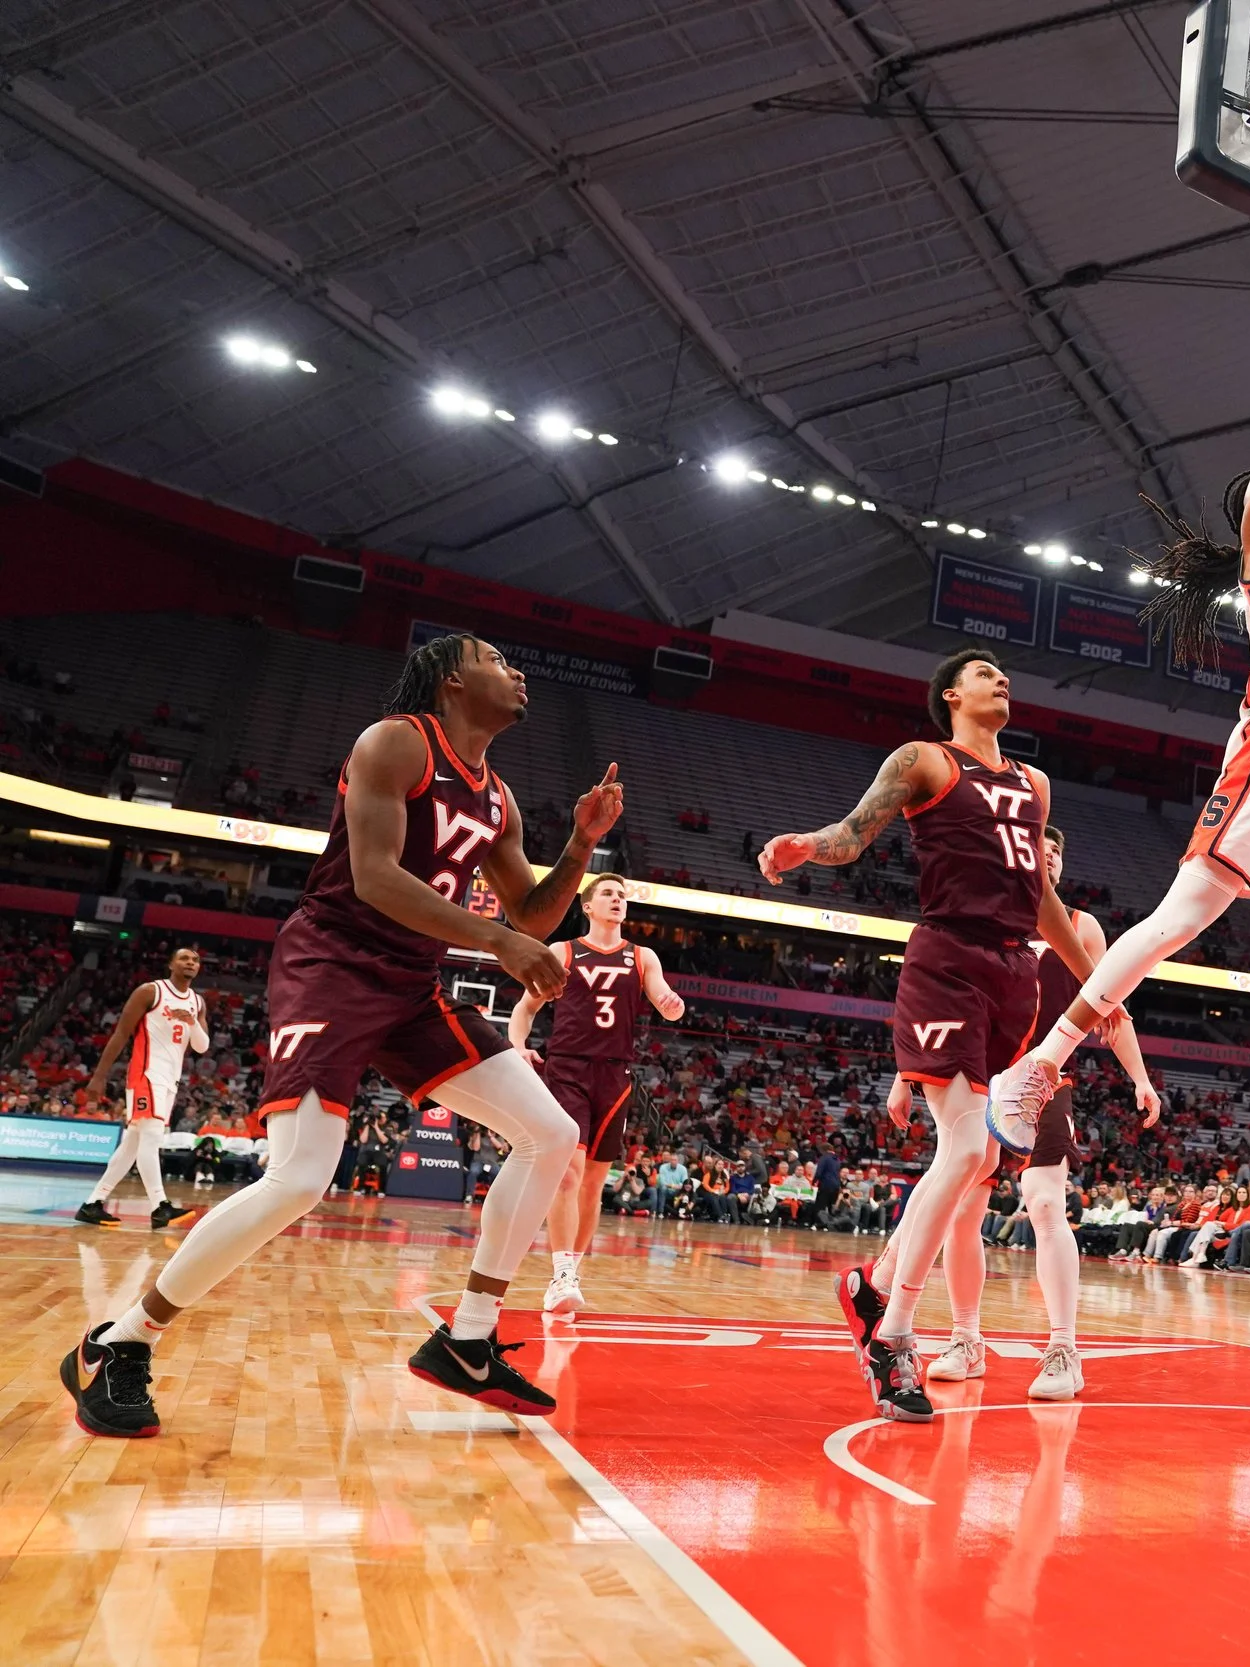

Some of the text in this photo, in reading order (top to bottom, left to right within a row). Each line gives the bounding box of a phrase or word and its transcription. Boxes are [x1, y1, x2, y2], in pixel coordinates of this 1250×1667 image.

[963, 617, 1007, 641] 2000
[545, 652, 567, 668] WE
[569, 657, 590, 673] DO
[1080, 641, 1123, 663] 2002
[1193, 670, 1231, 691] 2003
[969, 780, 1033, 818] VT
[1201, 794, 1230, 828] S
[432, 797, 499, 865] VT
[994, 823, 1036, 873] 15
[468, 891, 501, 918] 23
[576, 965, 633, 991] VT
[676, 979, 779, 1002] JIM BOEHEIM
[595, 994, 617, 1029] 3
[172, 1025, 183, 1044] 2
[270, 1022, 330, 1063] VT
[911, 1021, 967, 1052] VT
[1172, 1042, 1213, 1057] FLOYD
[137, 1097, 147, 1111] S
[0, 1126, 112, 1144] Healthcare Partner
[416, 1130, 453, 1141] TOYOTA
[420, 1158, 460, 1169] TOYOTA
